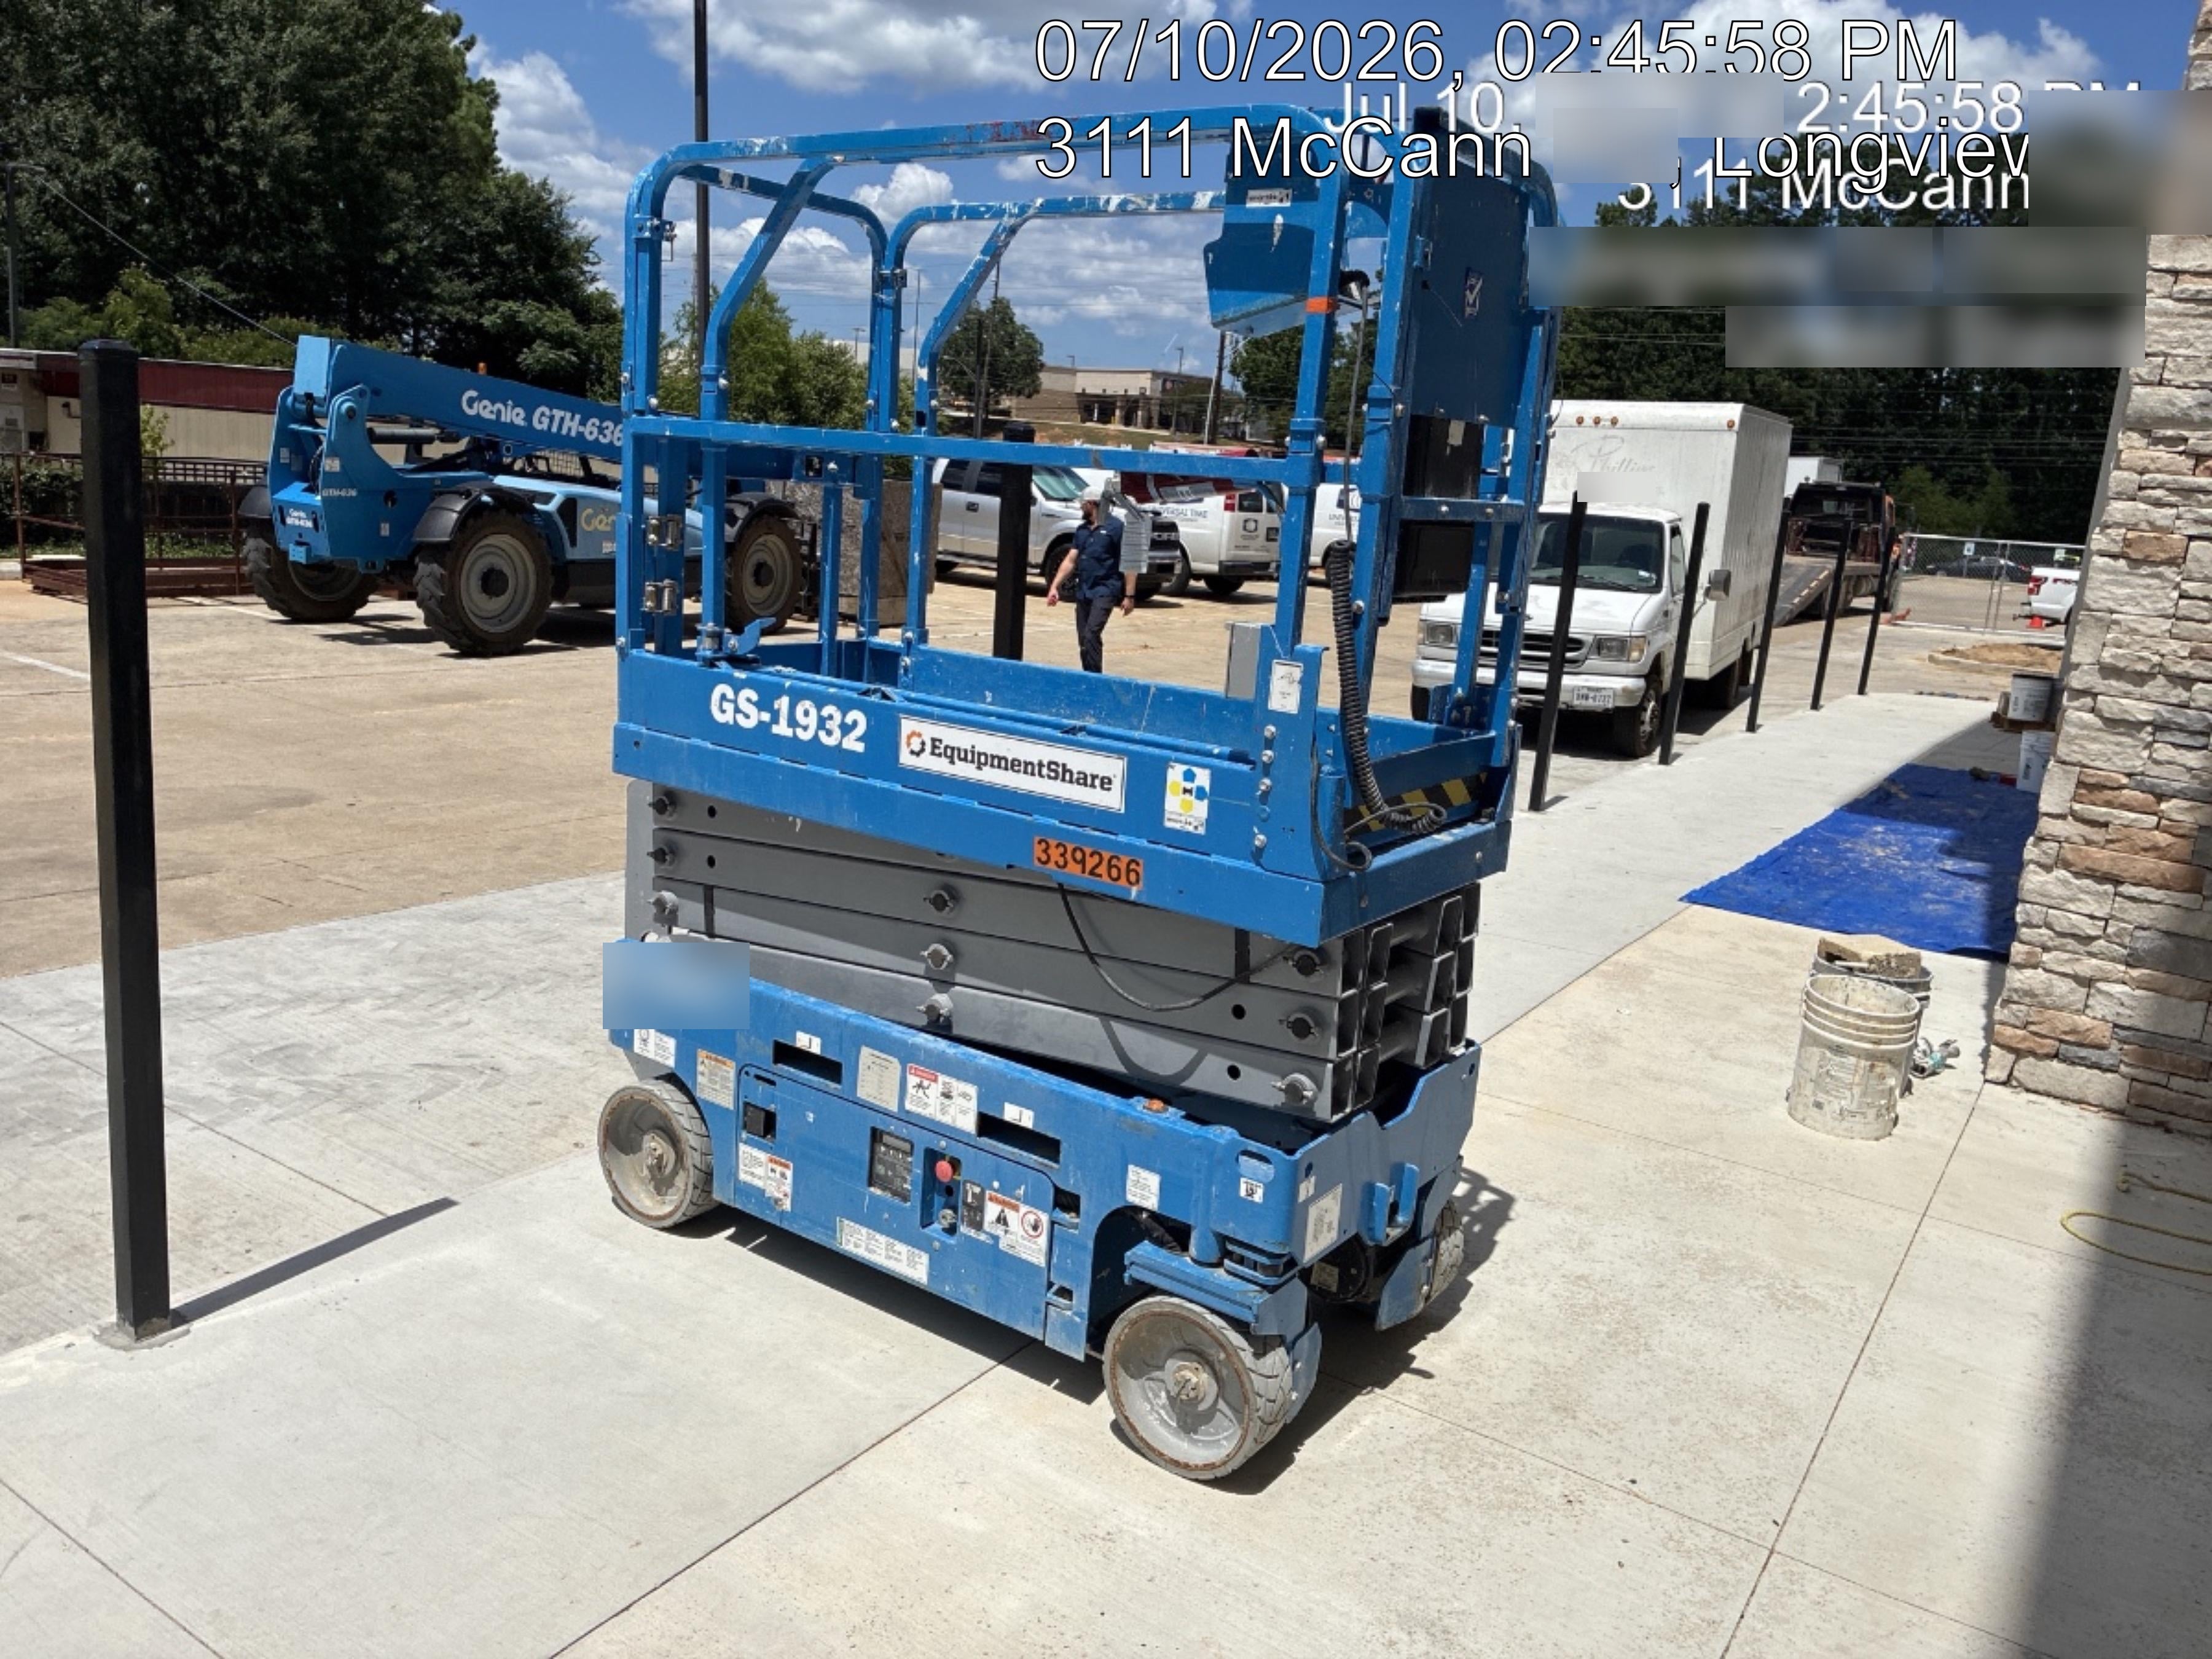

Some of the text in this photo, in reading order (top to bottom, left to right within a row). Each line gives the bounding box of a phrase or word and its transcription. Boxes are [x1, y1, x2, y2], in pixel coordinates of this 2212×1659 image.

[462, 390, 623, 447] Genie GTH-636
[710, 683, 868, 753] GS-1932
[930, 737, 1113, 792] EquipmentShare
[1036, 838, 1141, 886] 339266
